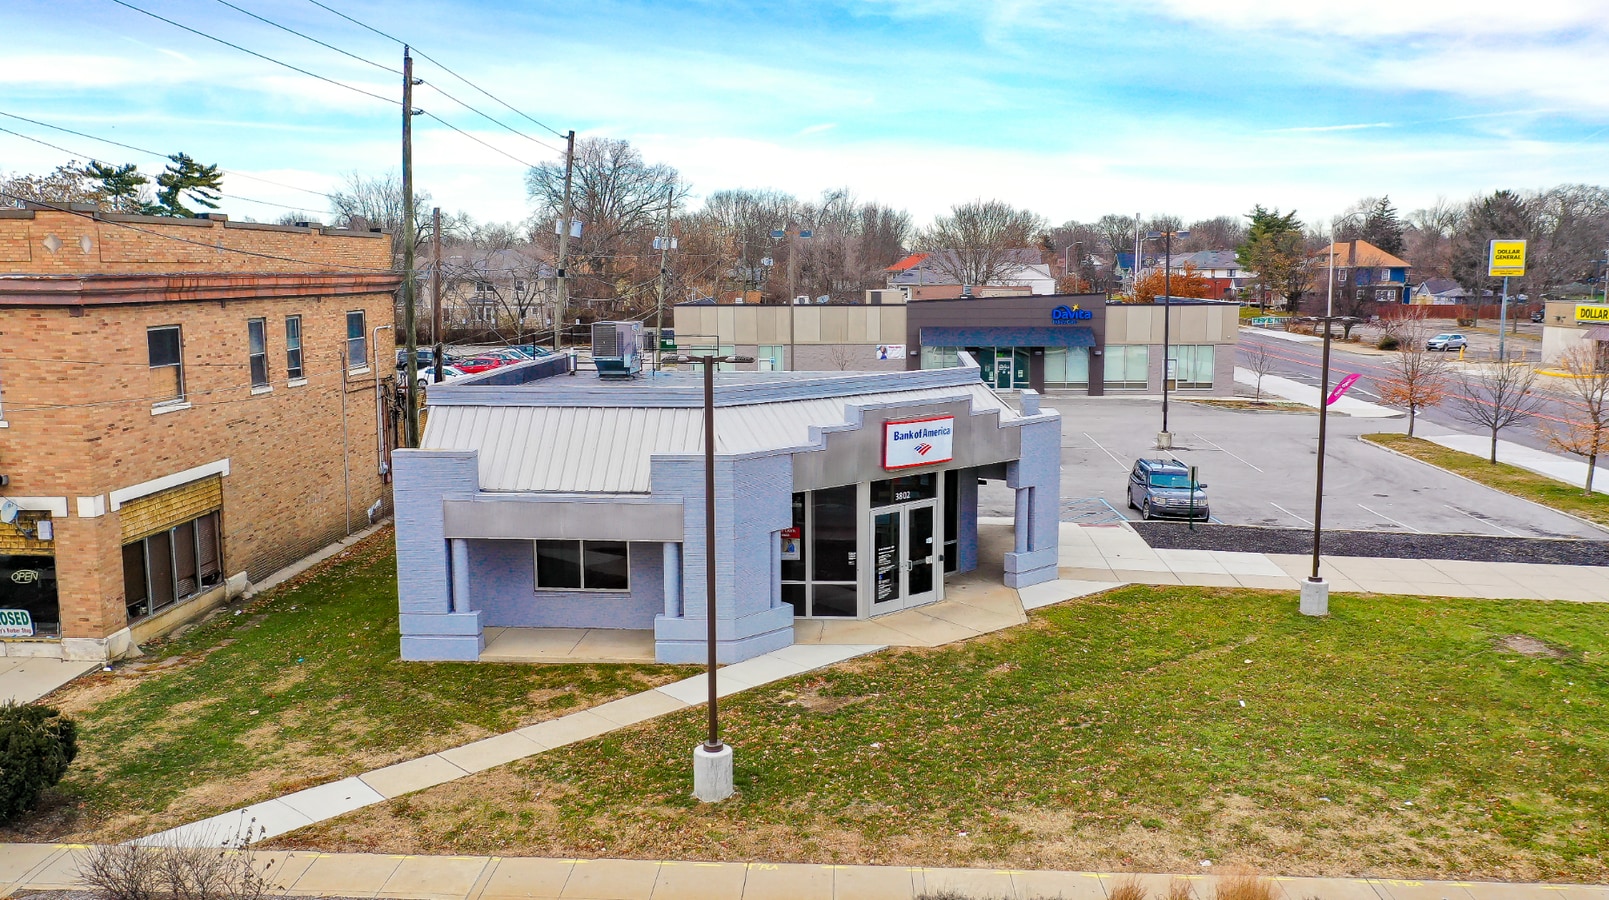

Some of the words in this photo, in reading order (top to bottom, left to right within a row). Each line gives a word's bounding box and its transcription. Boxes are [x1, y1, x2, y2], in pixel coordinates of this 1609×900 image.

[1580, 308, 1609, 319] DOLLAR
[893, 430, 914, 441] Bank
[914, 428, 922, 439] of
[922, 426, 951, 438] America
[895, 490, 911, 500] 3802
[11, 571, 39, 582] OPEN
[0, 611, 29, 625] OSED
